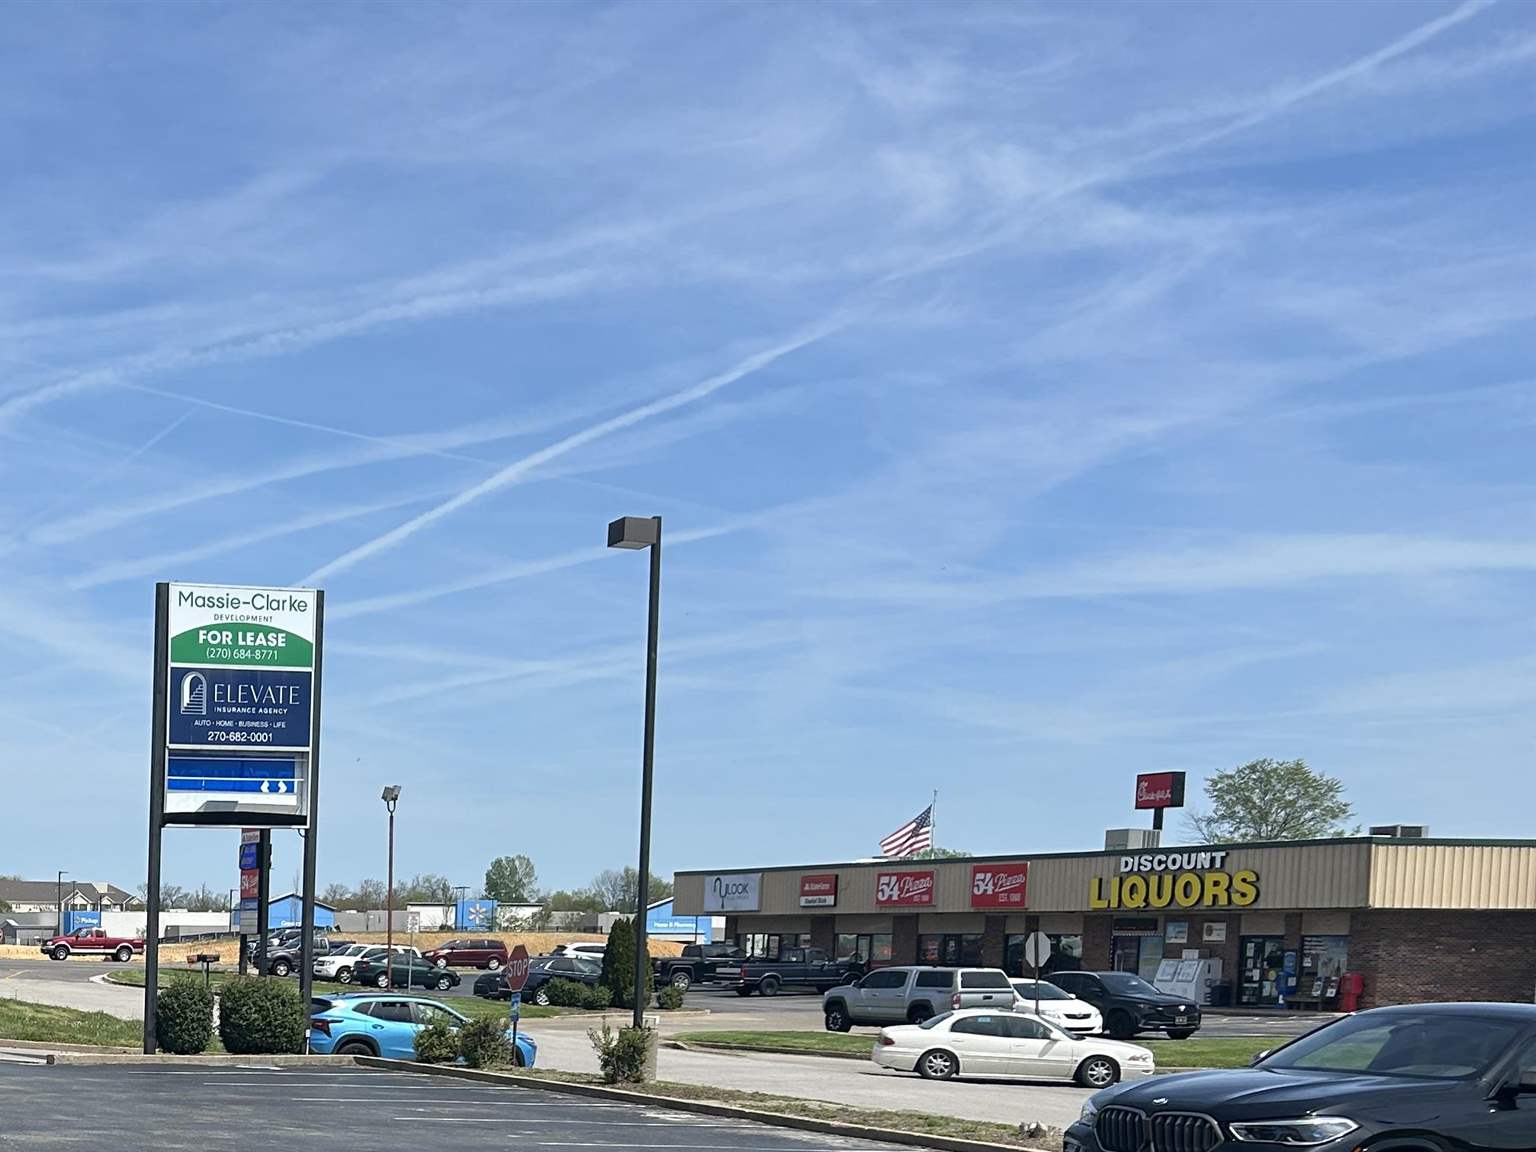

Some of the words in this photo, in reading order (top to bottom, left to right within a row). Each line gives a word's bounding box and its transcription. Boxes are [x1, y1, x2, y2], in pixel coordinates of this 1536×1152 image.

[178, 590, 308, 612] Massie-Clarke
[213, 613, 273, 622] DEVELOPMENT
[198, 630, 233, 645] FOR
[237, 632, 287, 647] LEASE
[206, 647, 231, 659] (270)
[232, 648, 278, 660] 684-8771
[214, 683, 300, 704] ELEVATE
[214, 706, 256, 714] INSURANCE
[258, 707, 288, 715] AGENCY
[238, 720, 269, 728] BUSINESS
[207, 731, 273, 743] 270-682-0001
[1120, 852, 1227, 873] DISCOUNT
[878, 876, 900, 901] 54
[973, 872, 994, 895] 54
[1089, 870, 1259, 909] LIQUORS
[508, 959, 528, 977] STOP
